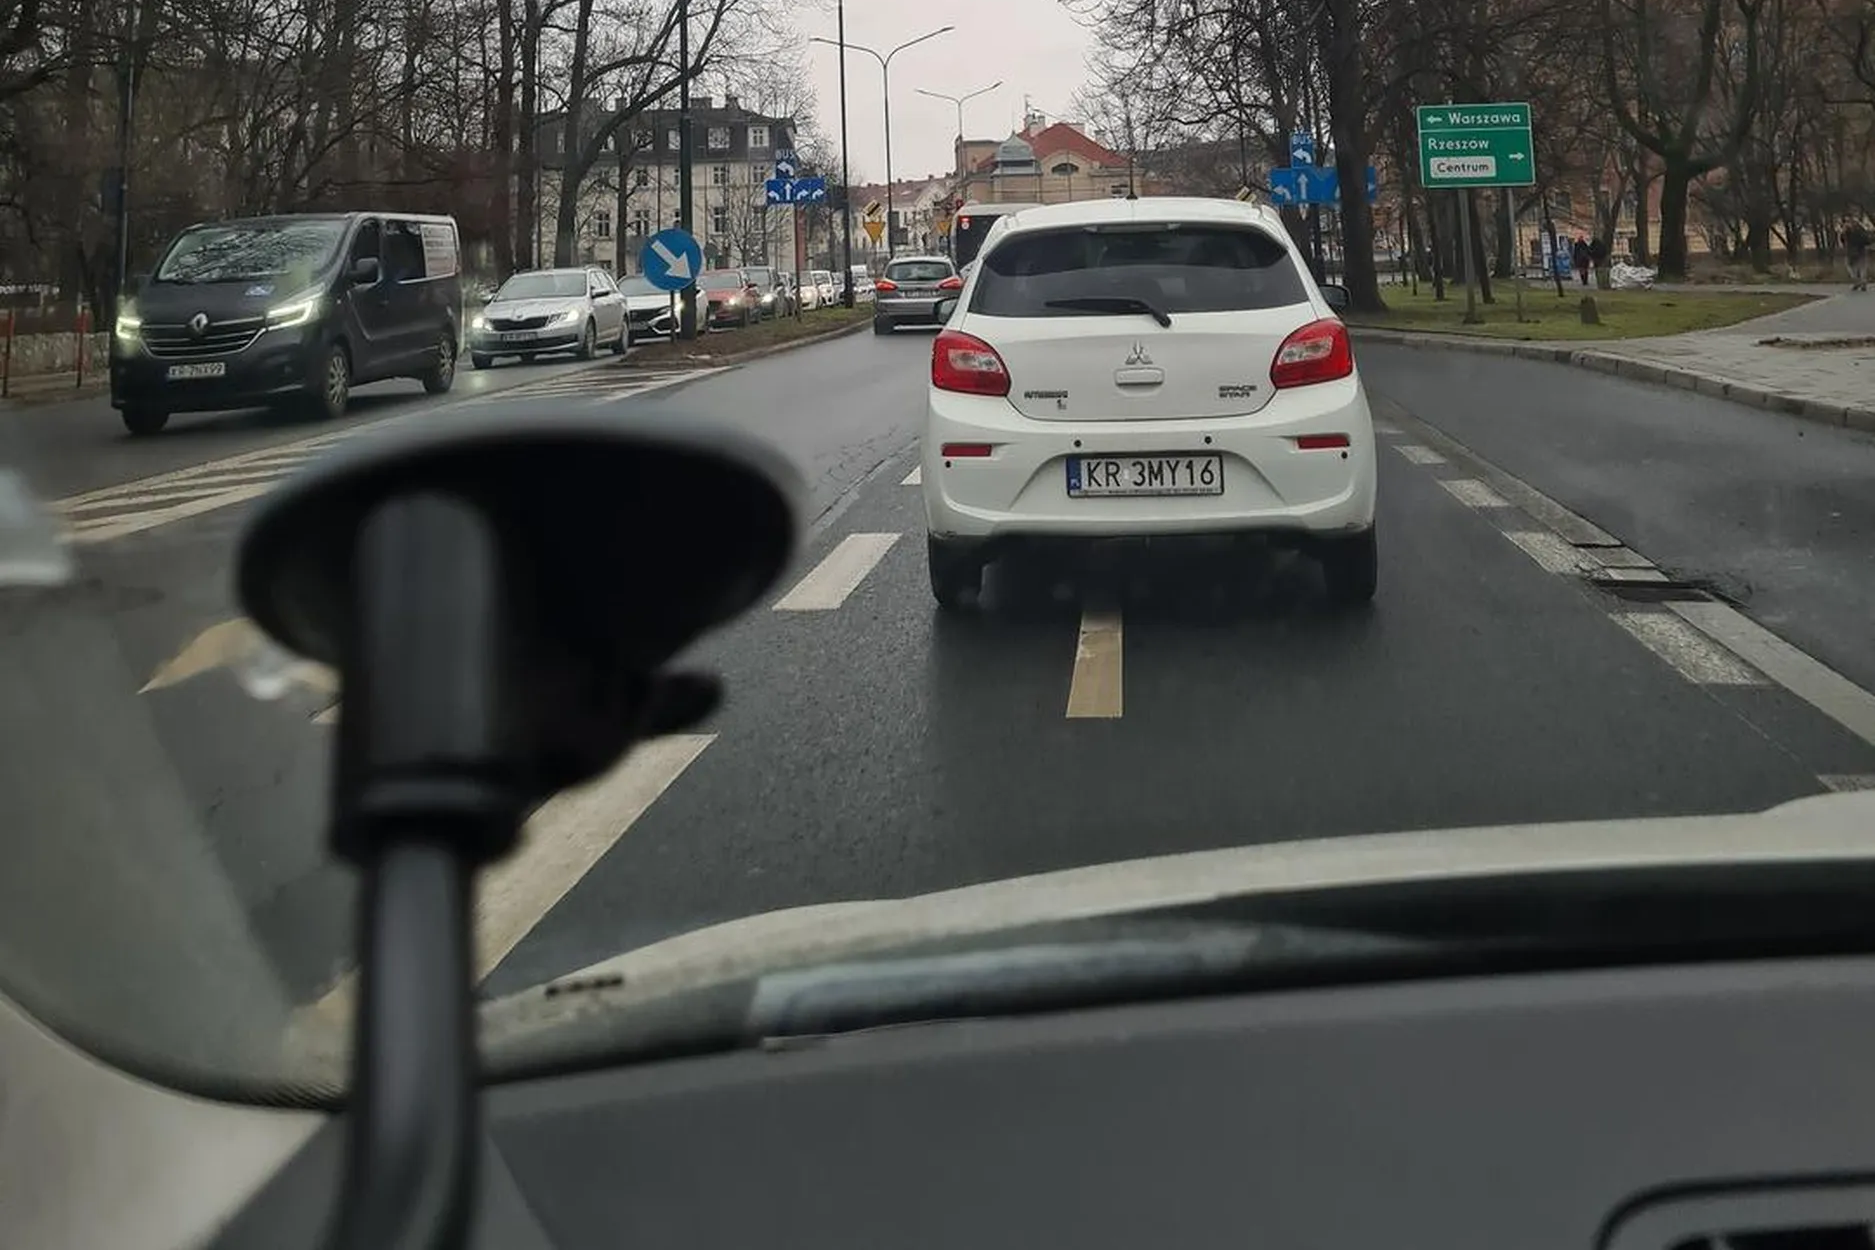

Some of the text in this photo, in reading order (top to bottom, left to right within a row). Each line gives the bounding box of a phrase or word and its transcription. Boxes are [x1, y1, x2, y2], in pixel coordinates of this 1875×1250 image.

[1448, 112, 1521, 125] Warszawa
[1428, 136, 1489, 150] Rzeszów
[1437, 162, 1489, 173] Centrum
[1087, 459, 1214, 487] KR 3MY16
